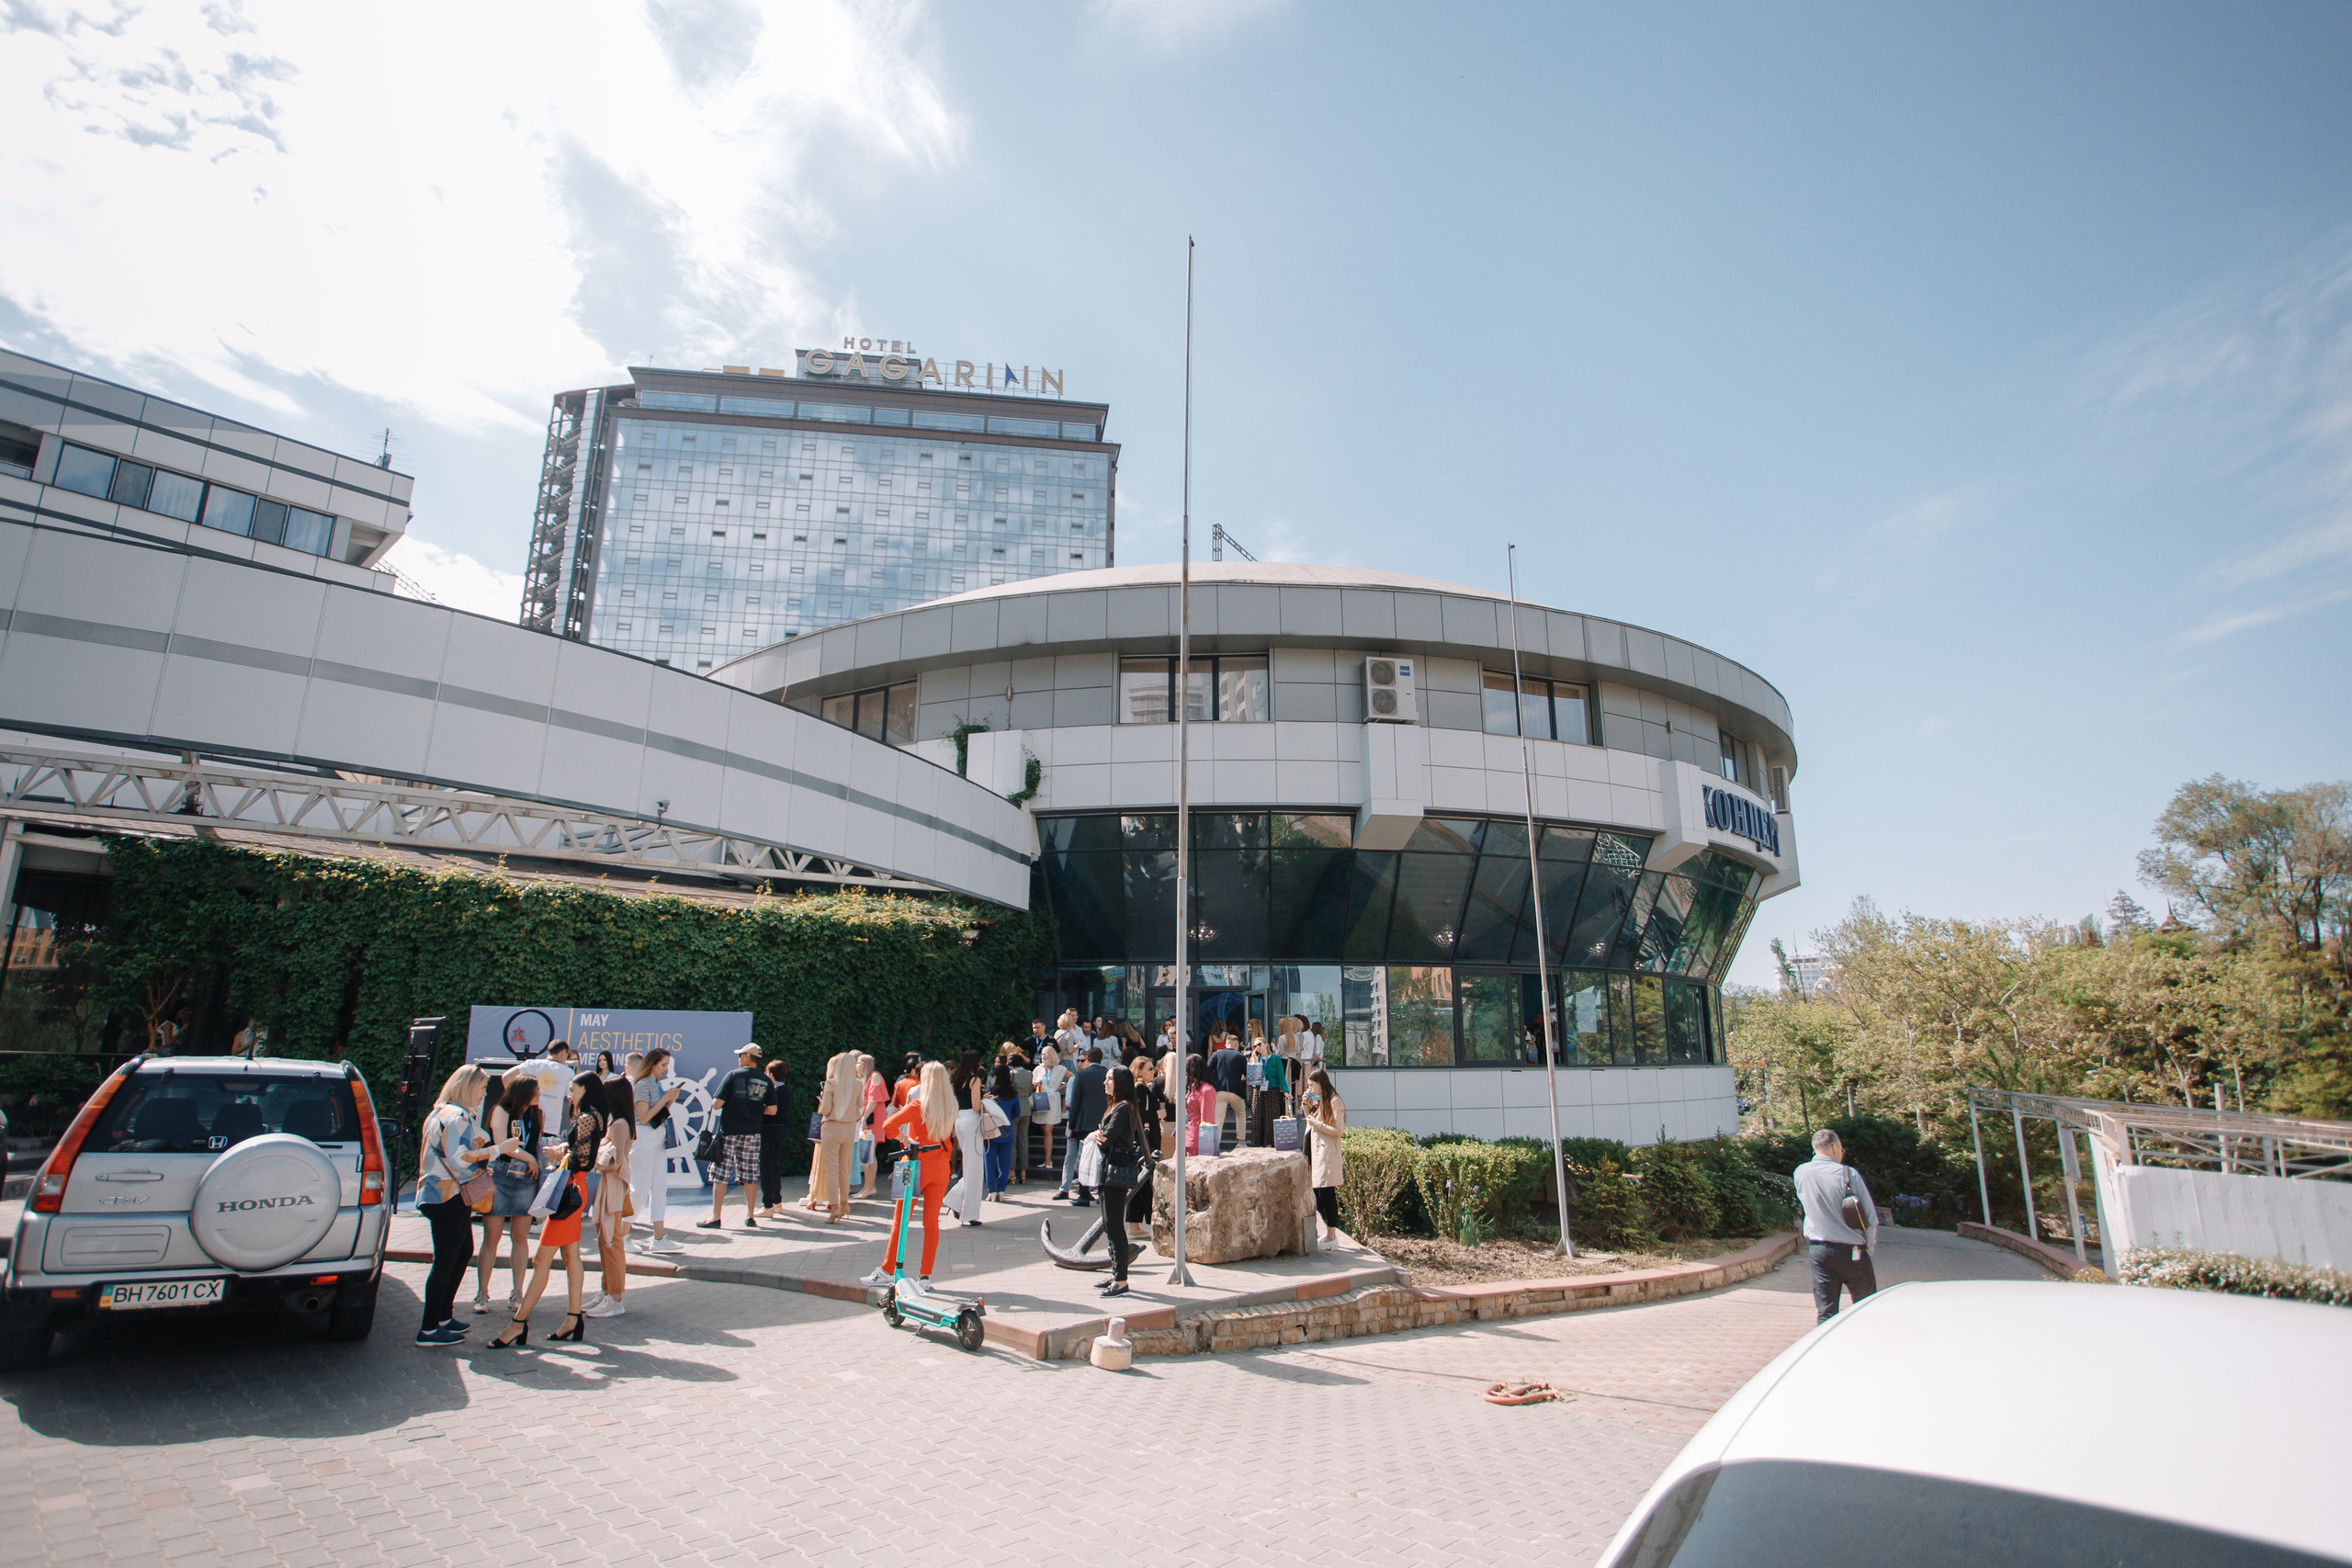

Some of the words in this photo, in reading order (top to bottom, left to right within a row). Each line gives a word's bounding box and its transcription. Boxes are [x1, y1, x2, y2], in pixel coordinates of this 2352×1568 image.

[844, 336, 917, 354] HOTEL
[580, 1013, 609, 1027] MAY
[577, 1031, 683, 1052] AESTHETICS
[217, 1195, 315, 1213] HONDA
[113, 1286, 143, 1303] BH
[146, 1283, 189, 1302] 7601
[193, 1281, 220, 1299] CX
